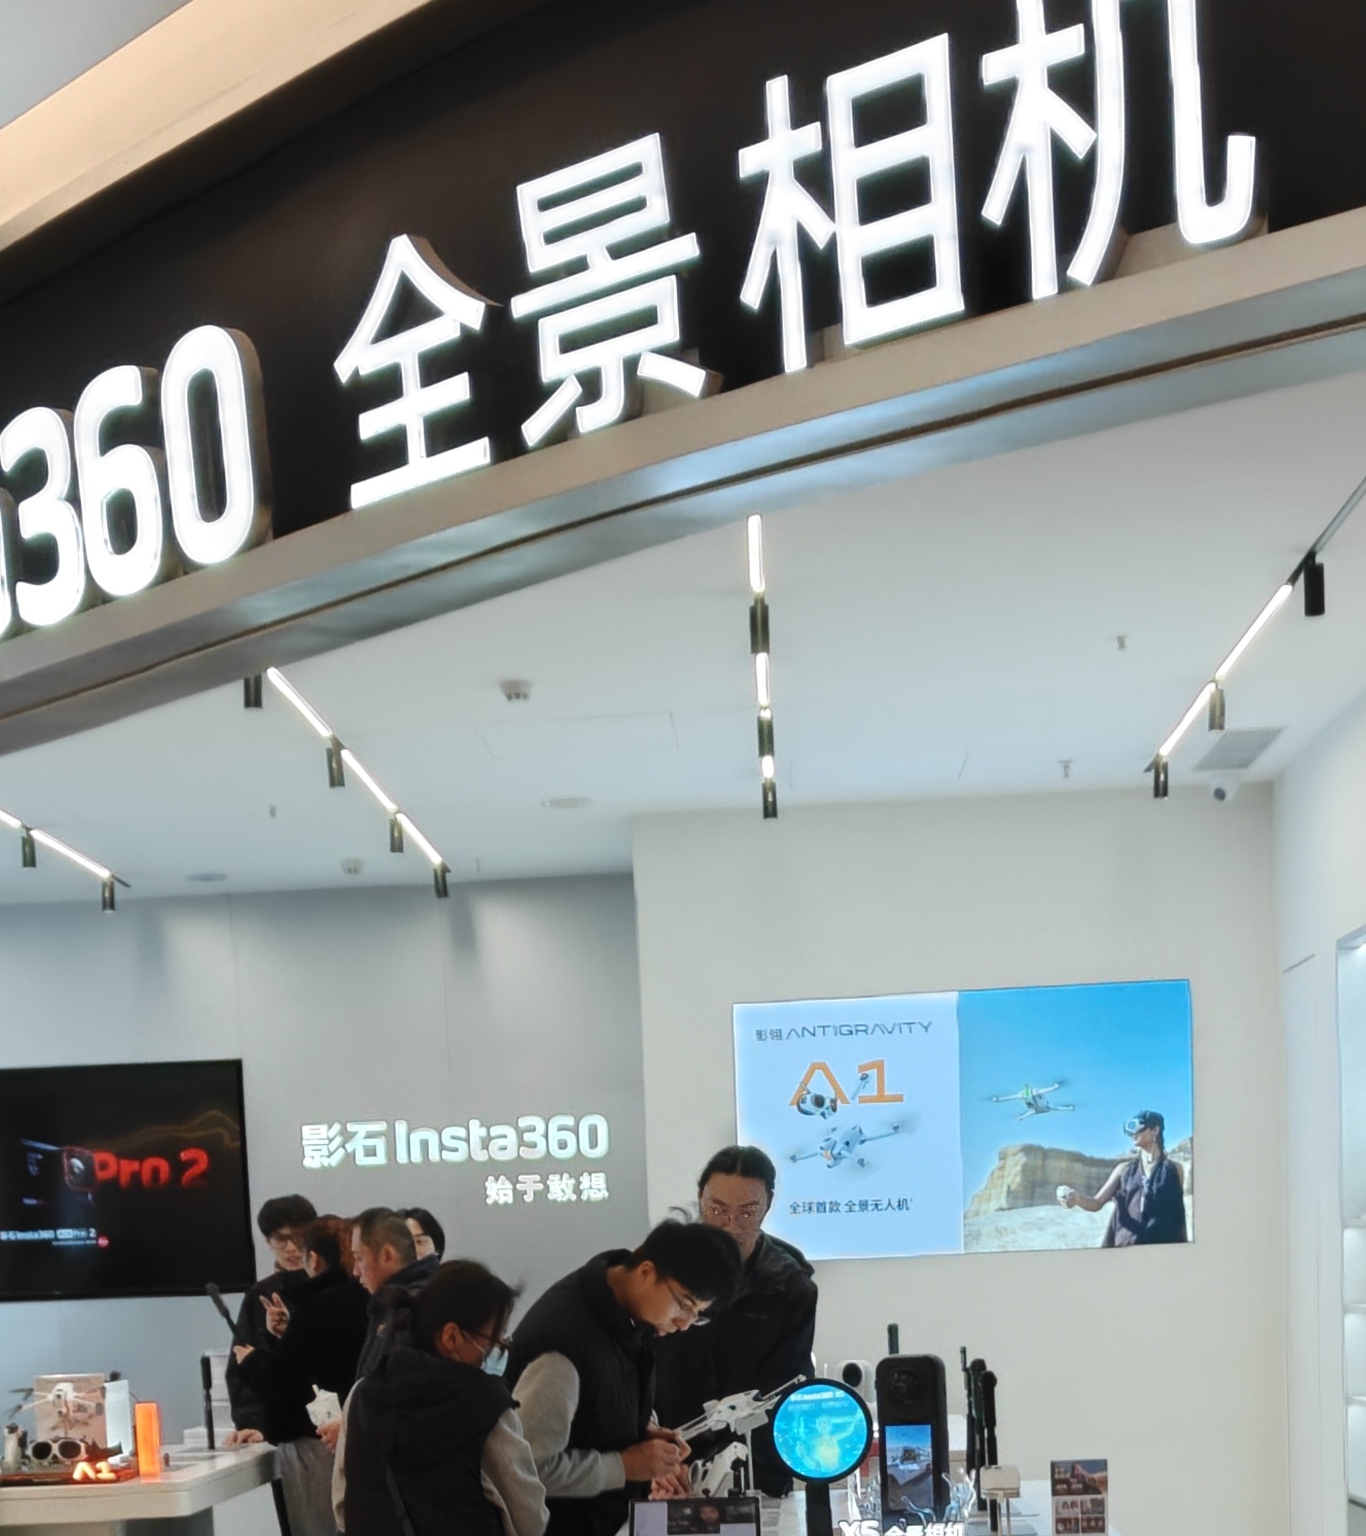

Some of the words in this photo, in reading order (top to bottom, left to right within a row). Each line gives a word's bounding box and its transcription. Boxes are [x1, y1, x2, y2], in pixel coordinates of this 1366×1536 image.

[331, 0, 1258, 511] 全景相机
[301, 1113, 610, 1169] 影石Insta360
[179, 1148, 211, 1186] 2
[485, 1172, 609, 1204] 始于敢想
[789, 1200, 841, 1214] 全球首款
